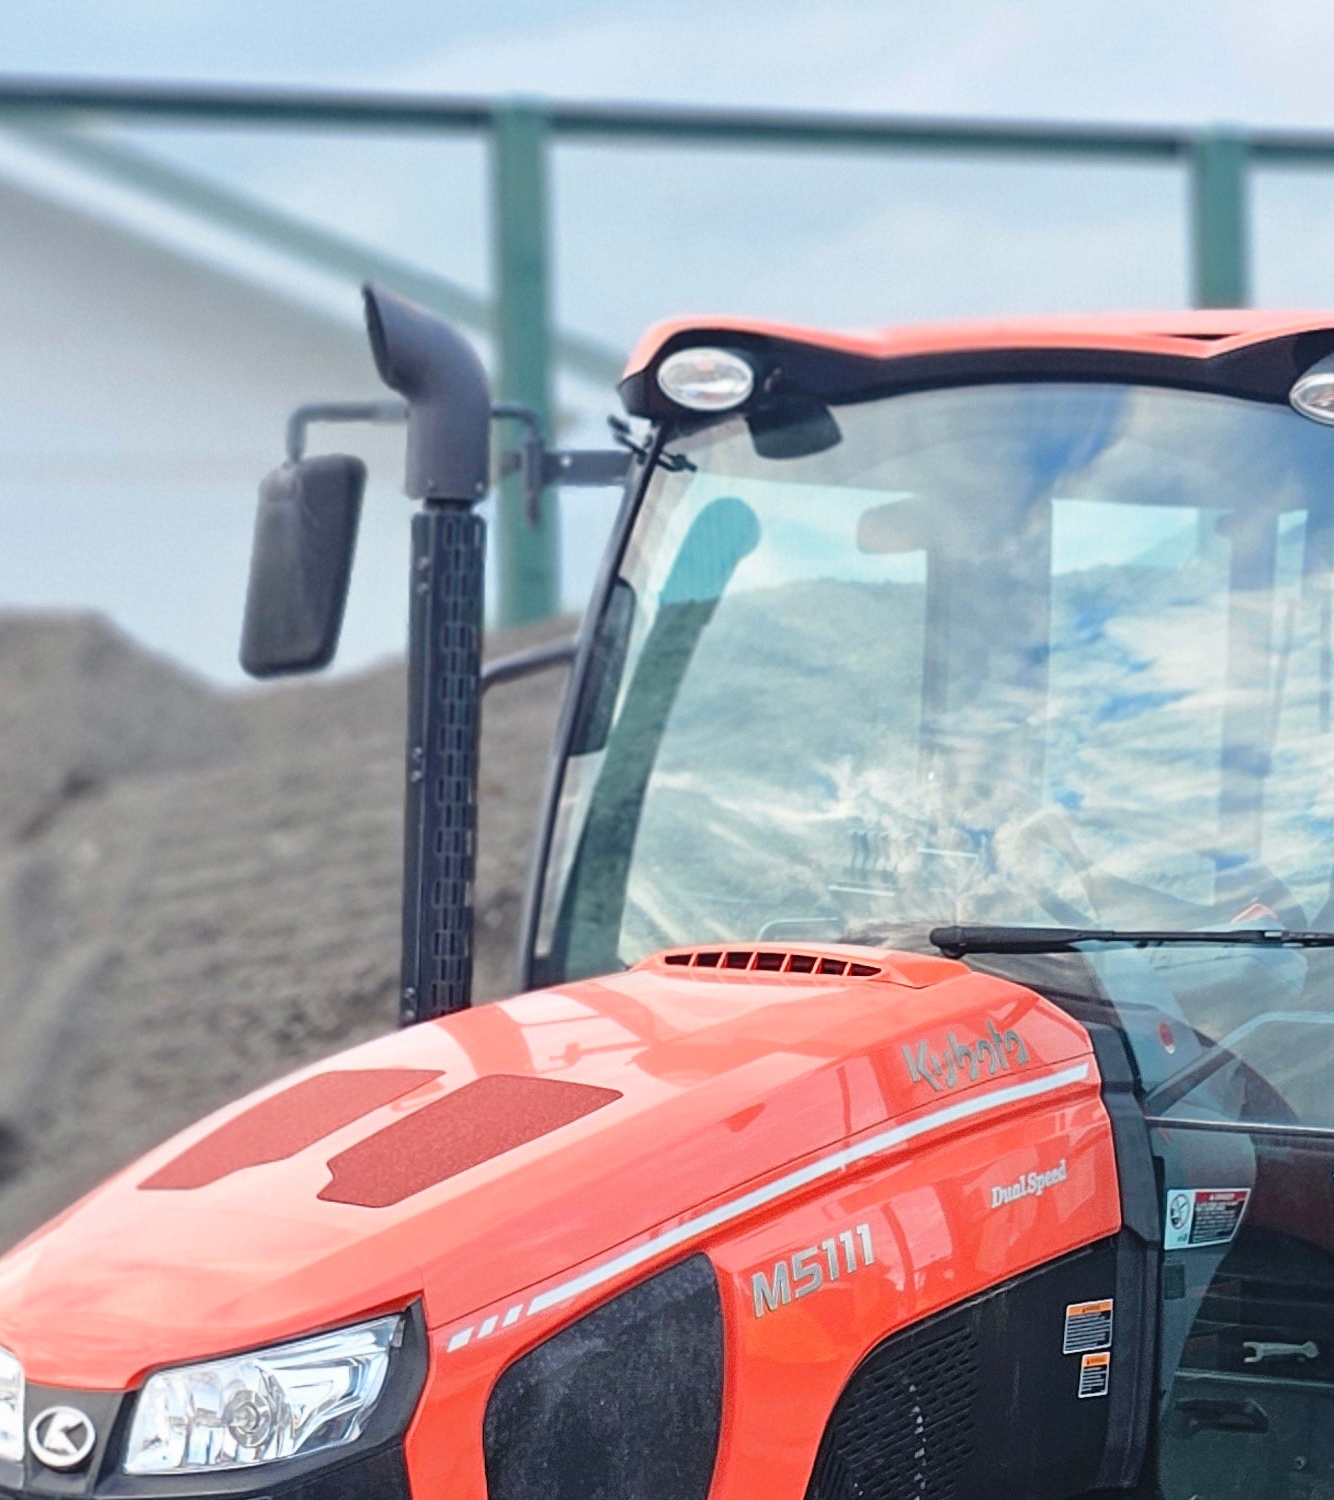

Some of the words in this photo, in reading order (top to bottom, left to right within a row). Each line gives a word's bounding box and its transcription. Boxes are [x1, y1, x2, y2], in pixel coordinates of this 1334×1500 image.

[901, 1020, 1029, 1092] Kubota
[991, 1174, 1027, 1209] Dual
[1027, 1158, 1068, 1197] Speed
[752, 1222, 875, 1319] M5111
